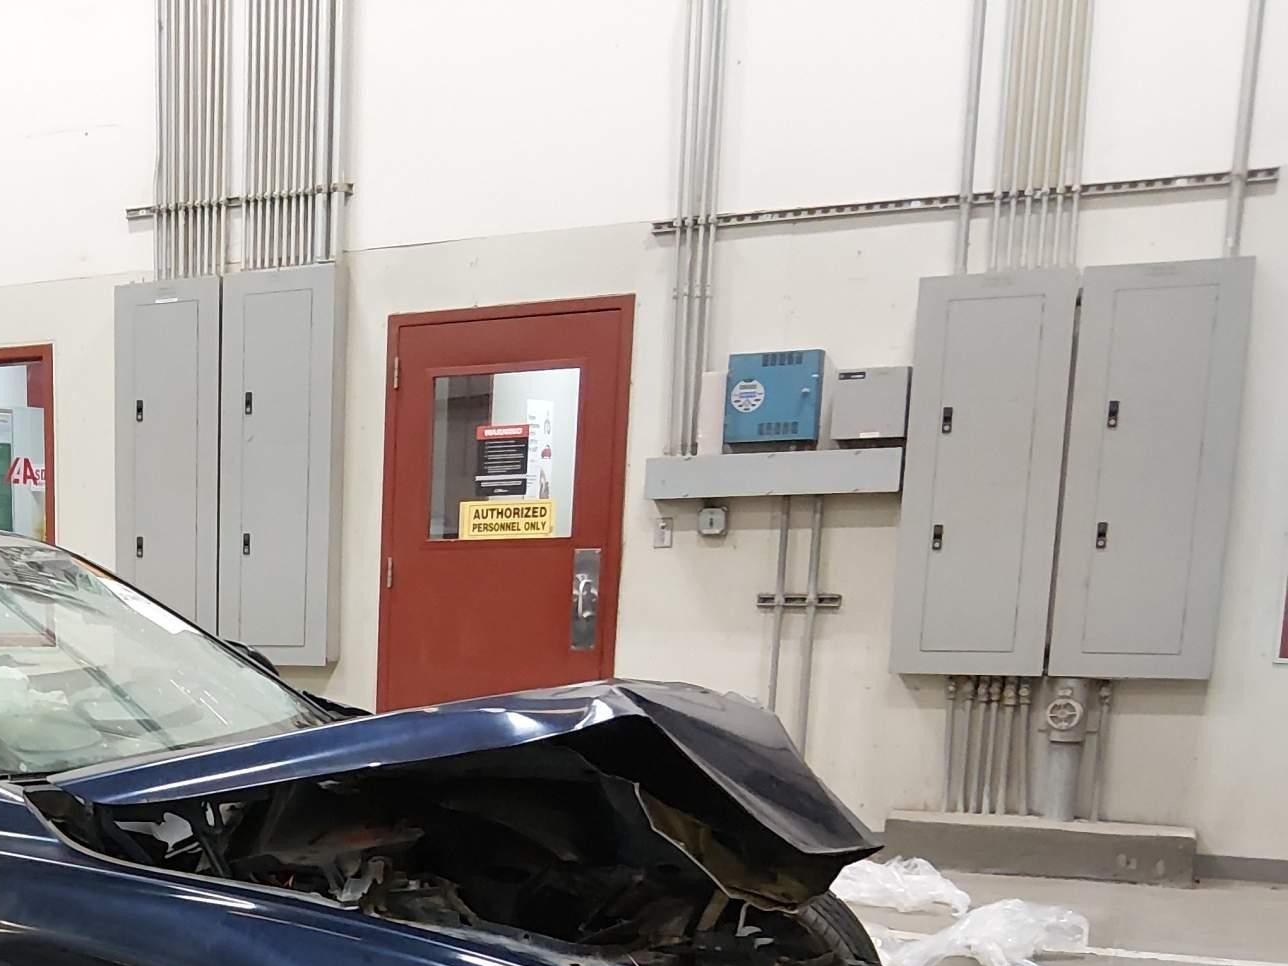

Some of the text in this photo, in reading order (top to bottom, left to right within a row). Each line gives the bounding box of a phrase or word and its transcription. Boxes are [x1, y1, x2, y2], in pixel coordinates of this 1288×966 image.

[473, 506, 547, 520] AUTHORIZED
[472, 521, 547, 533] PERSONNEL ONLY
